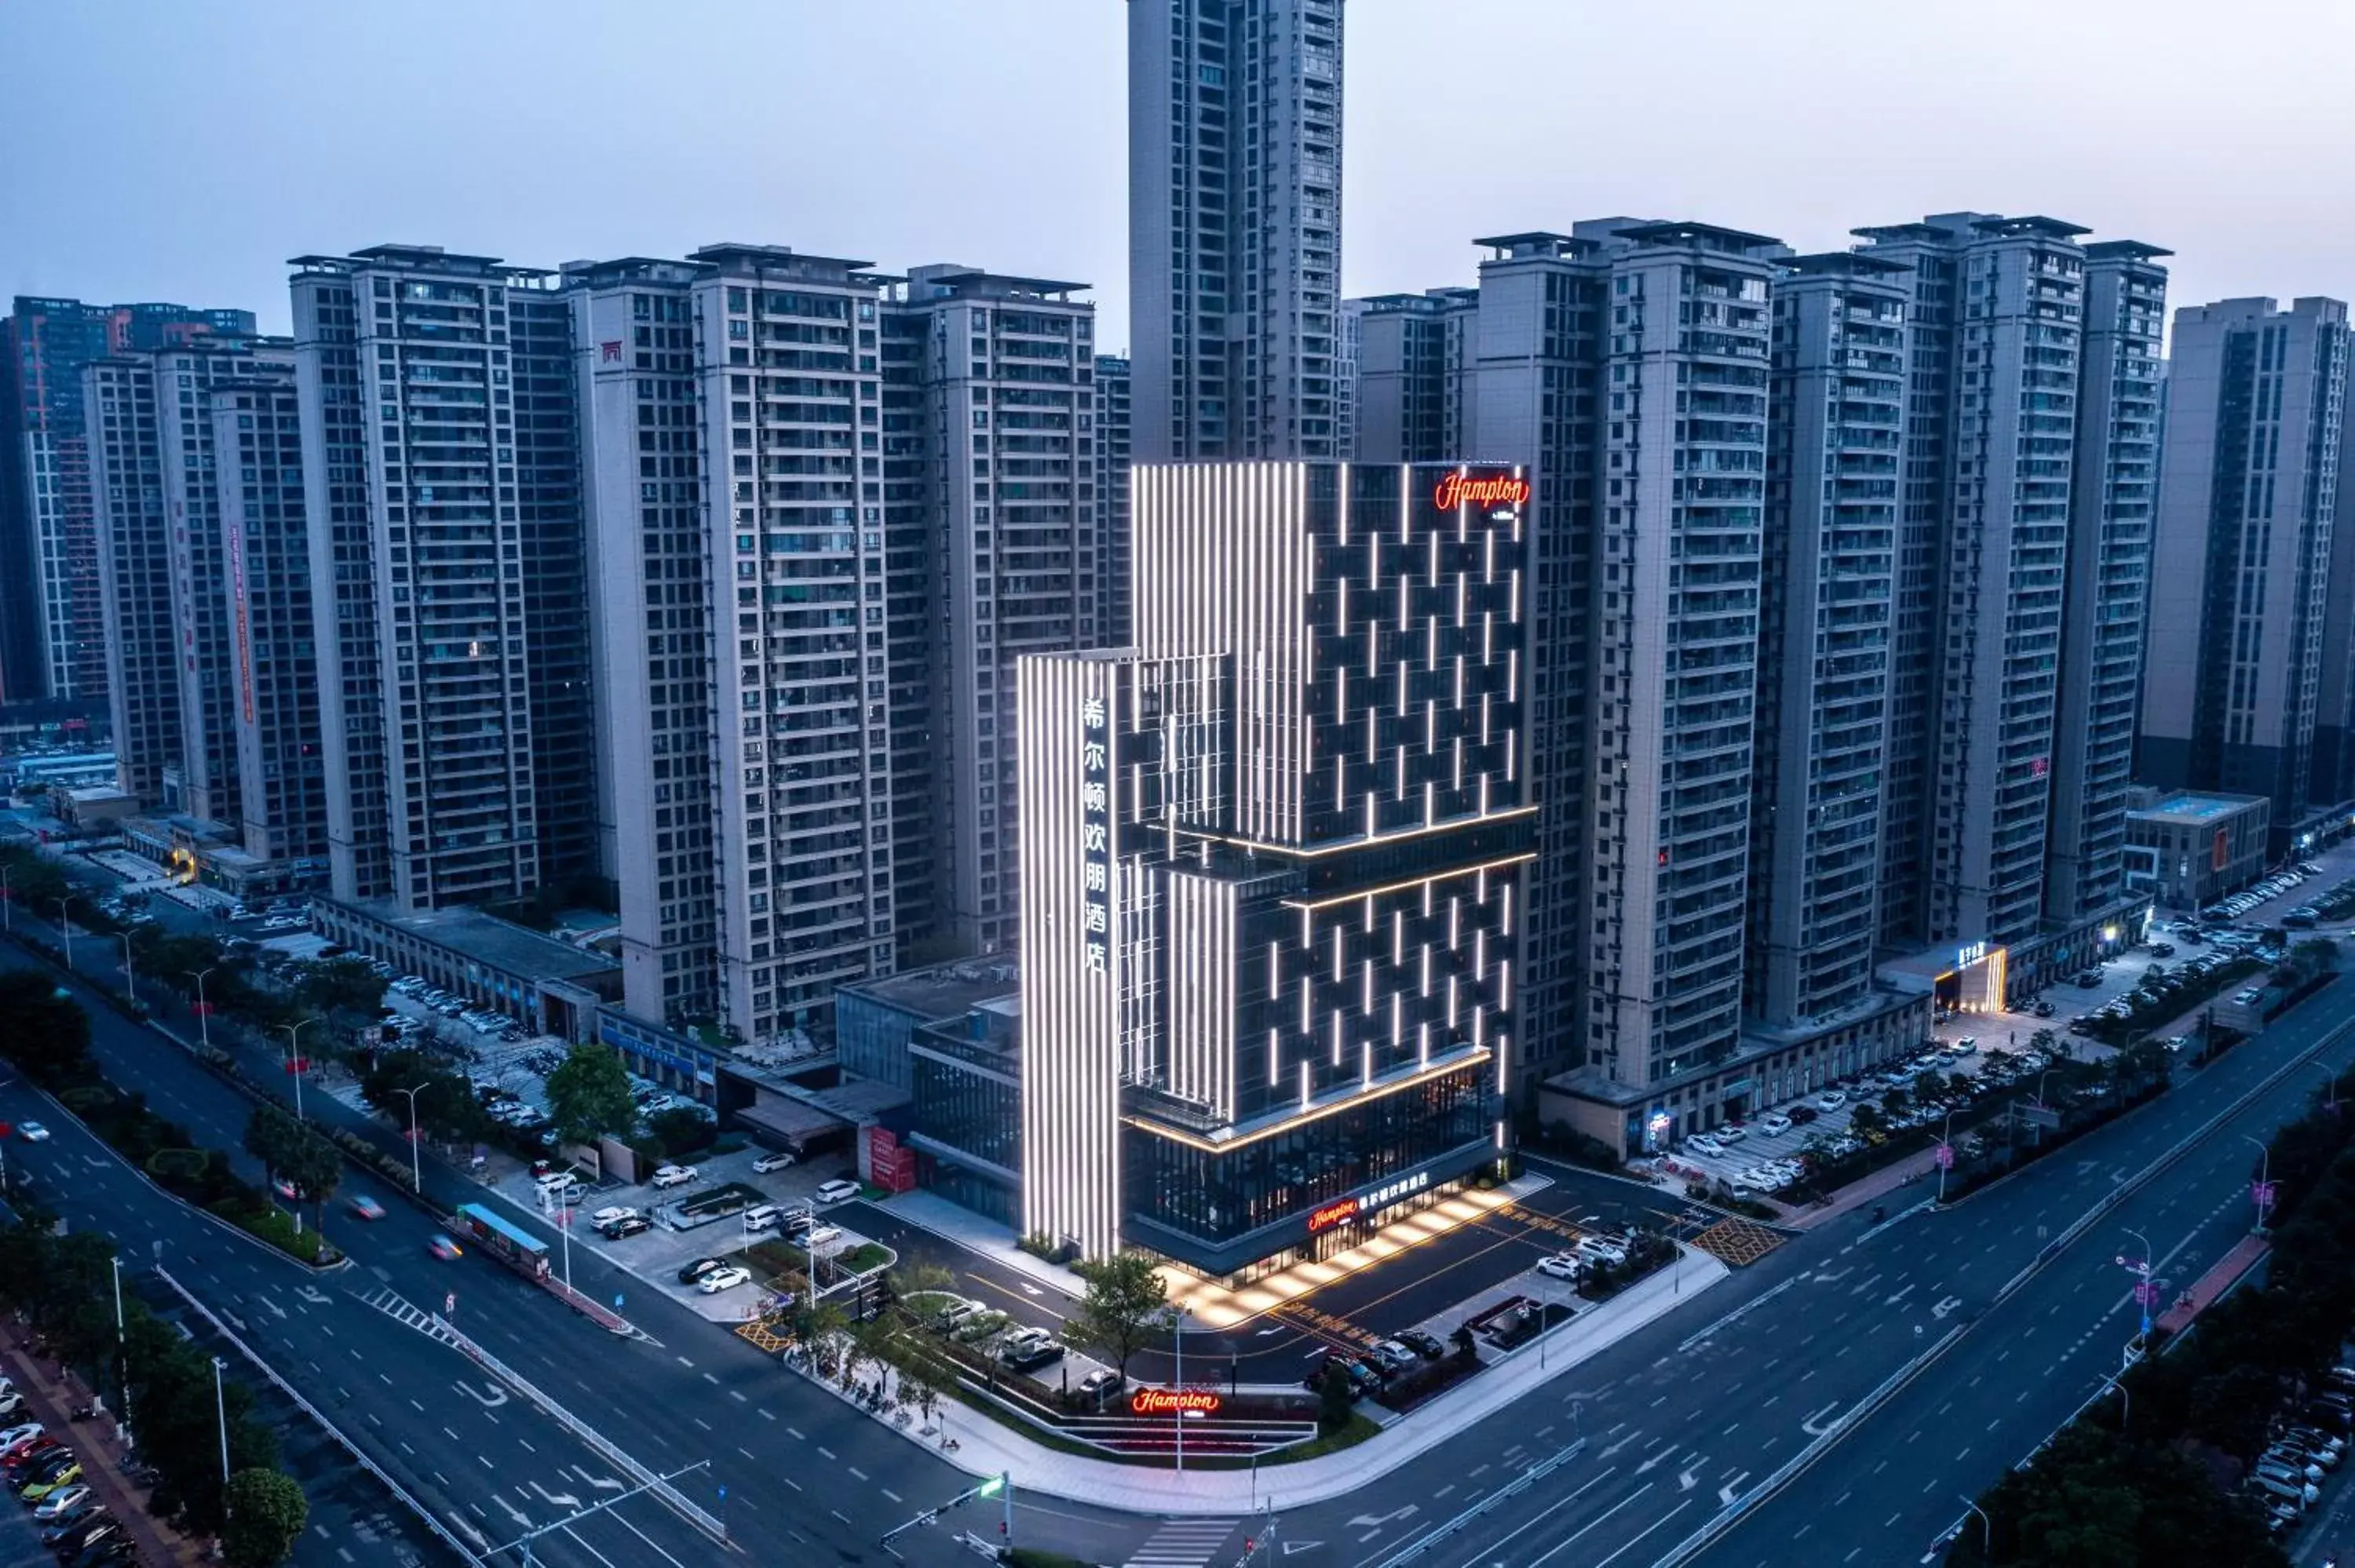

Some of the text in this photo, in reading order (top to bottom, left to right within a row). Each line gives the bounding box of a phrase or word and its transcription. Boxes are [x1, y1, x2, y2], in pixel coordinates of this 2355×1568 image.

[1436, 473, 1530, 509] Hampton
[1084, 697, 1106, 973] 希尔顿欢朋酒店
[1133, 1391, 1218, 1412] Hampton
